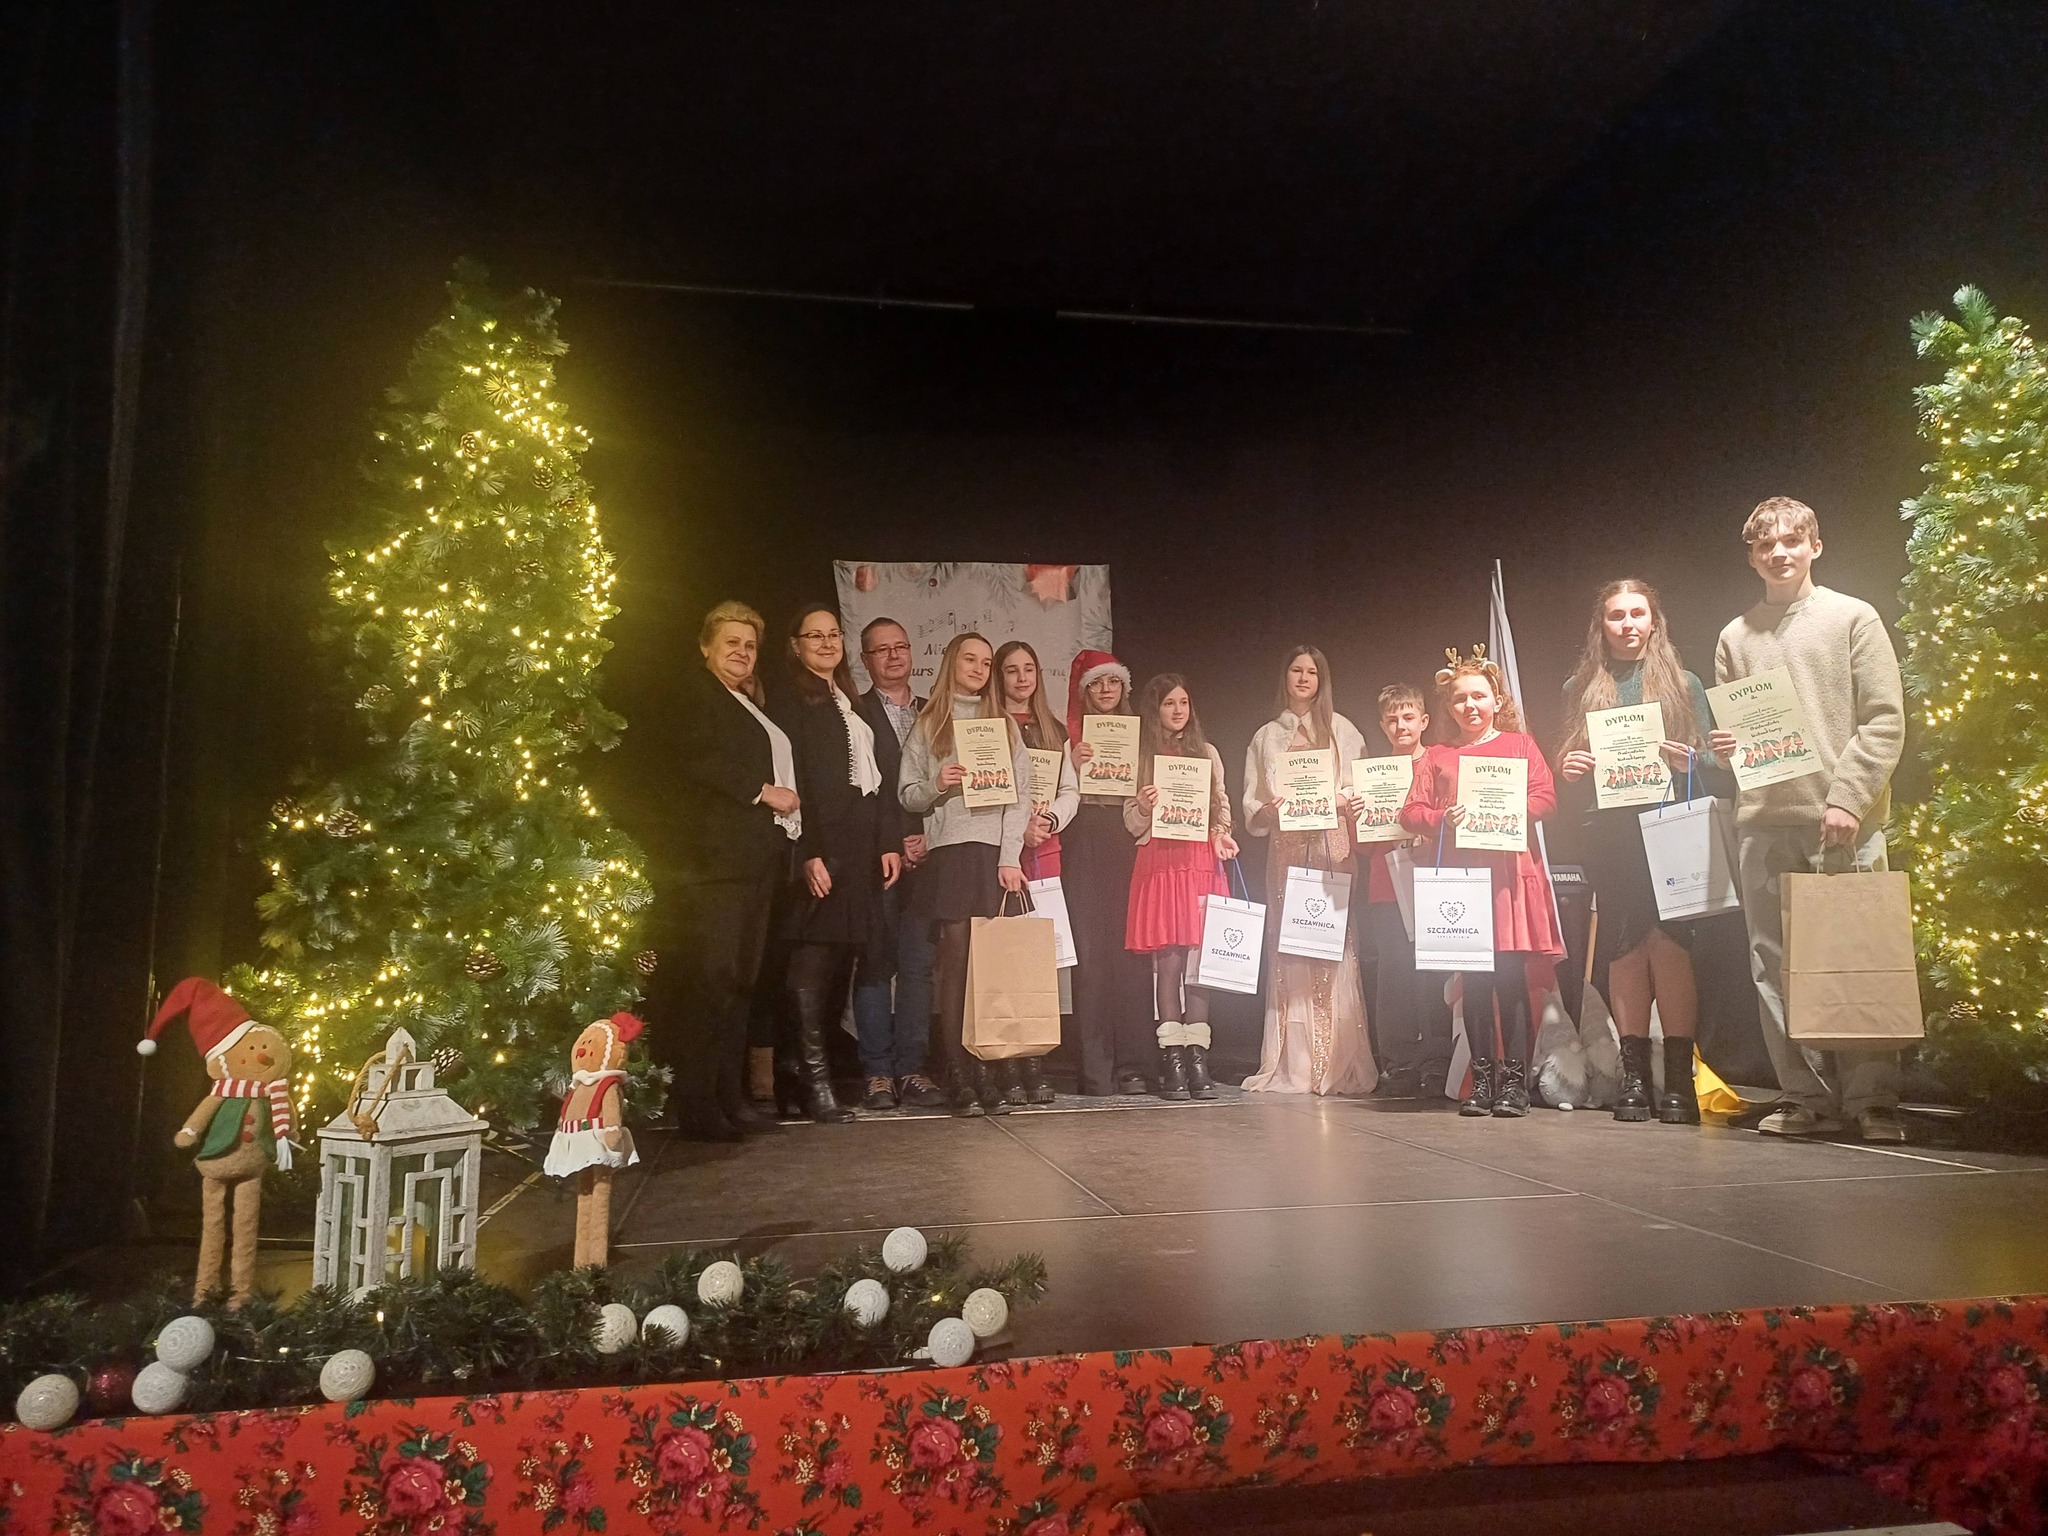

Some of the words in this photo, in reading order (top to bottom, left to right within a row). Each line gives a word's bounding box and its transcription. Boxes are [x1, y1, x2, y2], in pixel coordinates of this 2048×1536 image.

[1729, 682, 1773, 702] DYPLOM
[1605, 714, 1644, 726] DYPLOM
[966, 726, 994, 735] DYPLOM
[1096, 722, 1127, 730] DYPLOM
[1029, 756, 1050, 765] PLOM
[1289, 758, 1318, 766] DYPLOM
[1168, 764, 1198, 773] DYPLOM
[1366, 764, 1398, 774] DYPLOM
[1475, 765, 1511, 775] DYPLOM
[1552, 873, 1581, 882] YAMAHA
[1292, 918, 1335, 929] SZCZAWNICA
[1211, 948, 1250, 960] SZCZAWNICA
